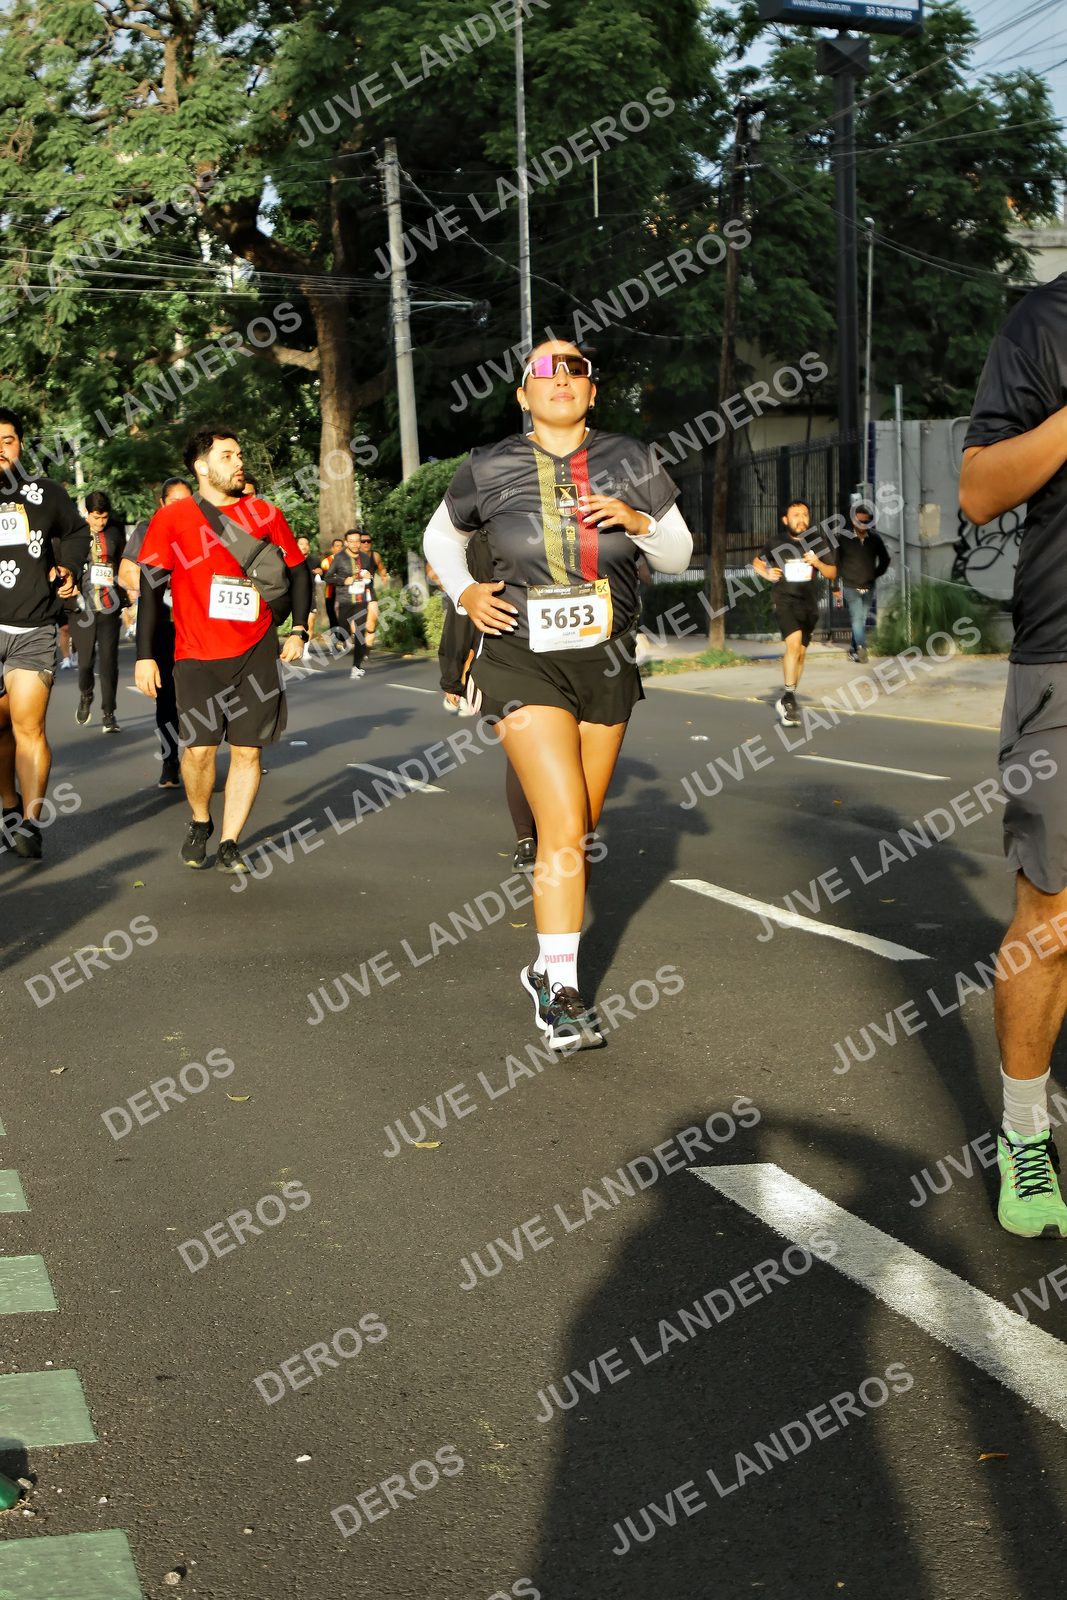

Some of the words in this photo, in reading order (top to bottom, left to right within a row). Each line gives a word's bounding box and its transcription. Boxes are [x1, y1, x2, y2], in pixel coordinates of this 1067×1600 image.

[2, 518, 17, 530] 09
[218, 591, 250, 605] 5155
[541, 605, 594, 629] 5653
[545, 953, 574, 963] PUMA
